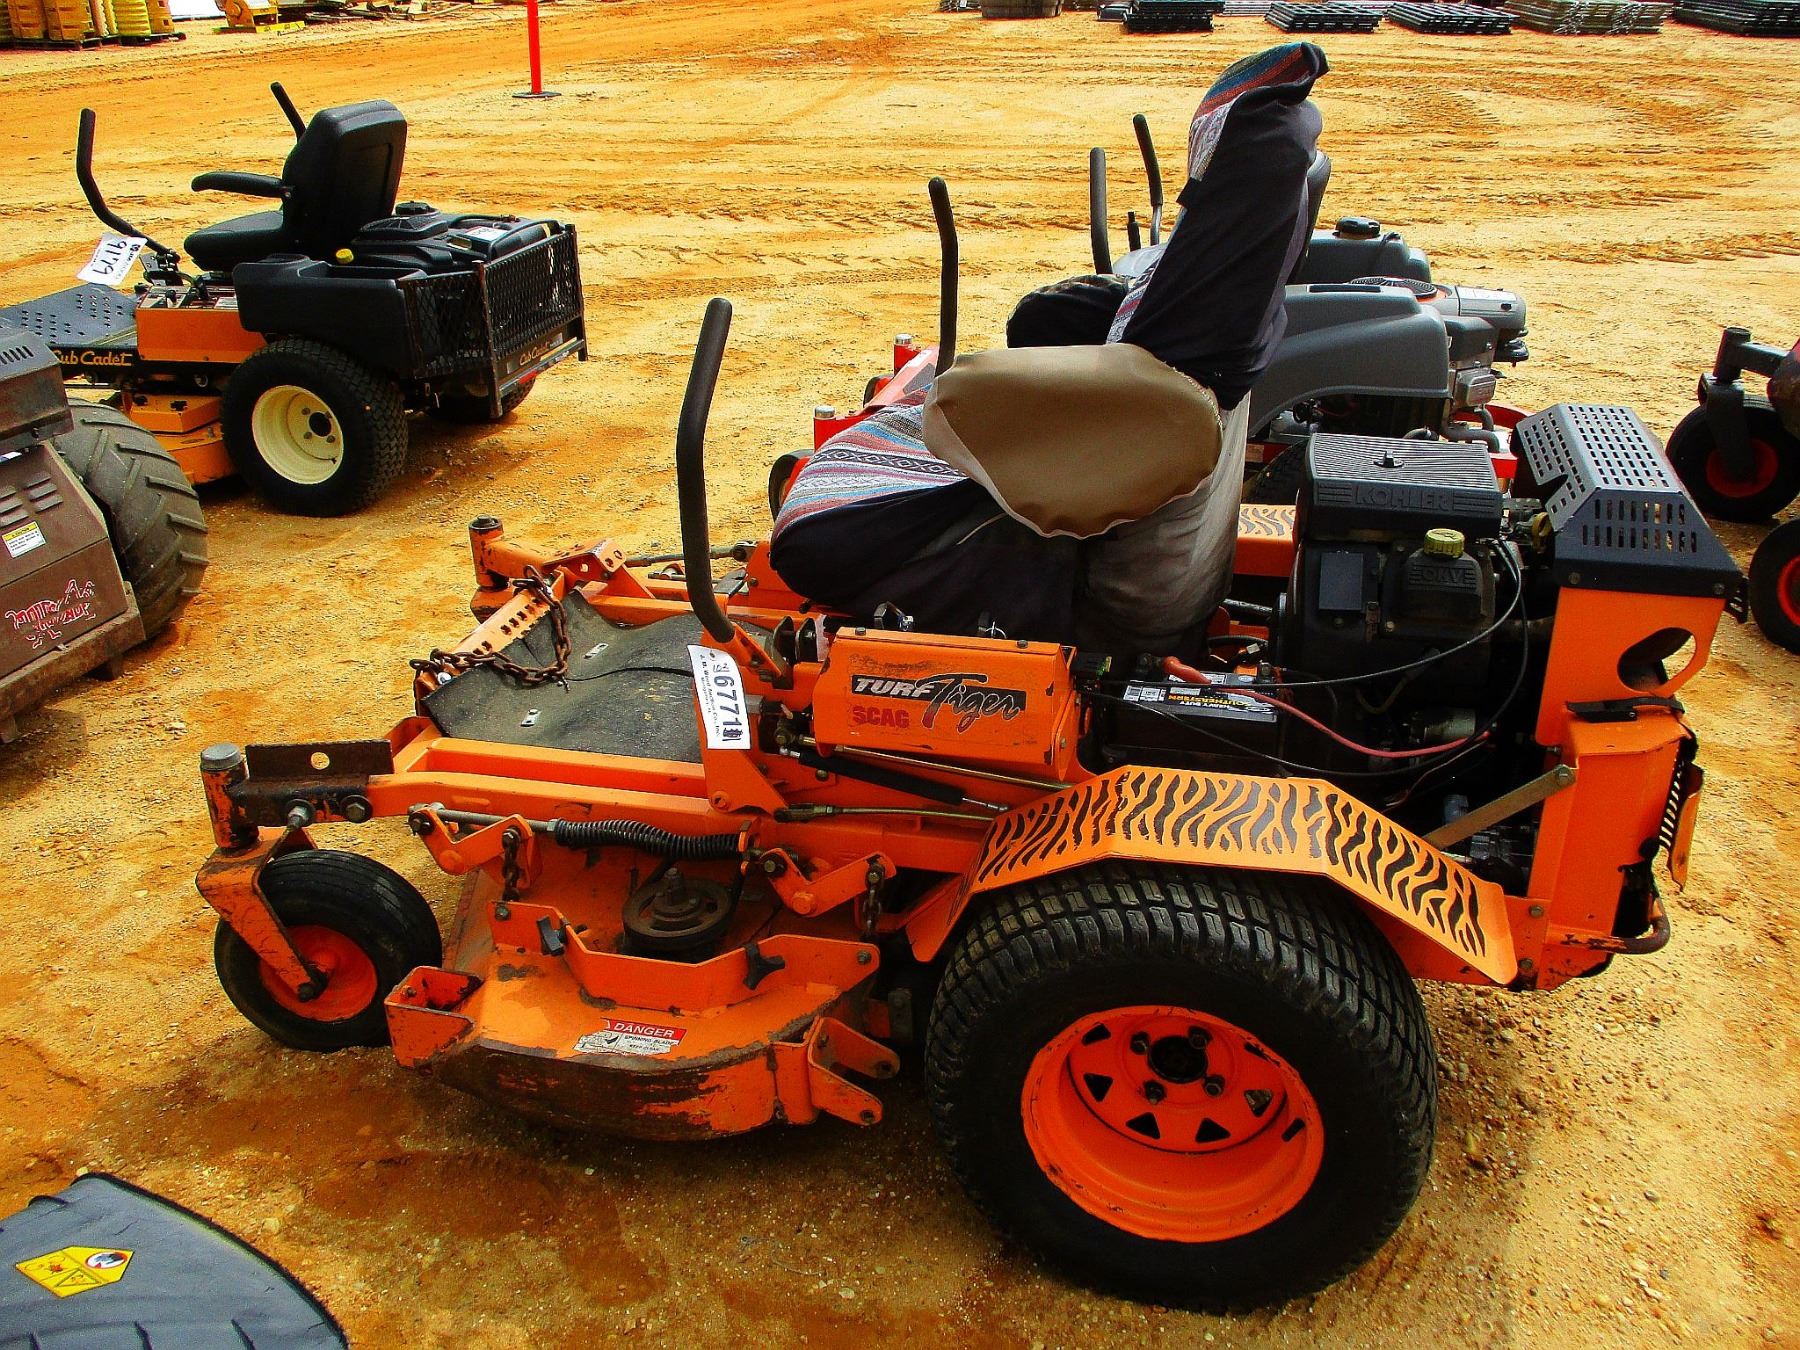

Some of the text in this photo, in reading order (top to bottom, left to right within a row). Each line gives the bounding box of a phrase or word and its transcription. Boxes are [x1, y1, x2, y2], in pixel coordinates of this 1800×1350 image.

[80, 350, 133, 366] Cadet
[1356, 485, 1450, 512] KOHLER
[855, 673, 1021, 734] TURF Tiger
[852, 705, 910, 729] SCAG
[614, 1022, 675, 1038] DANGER
